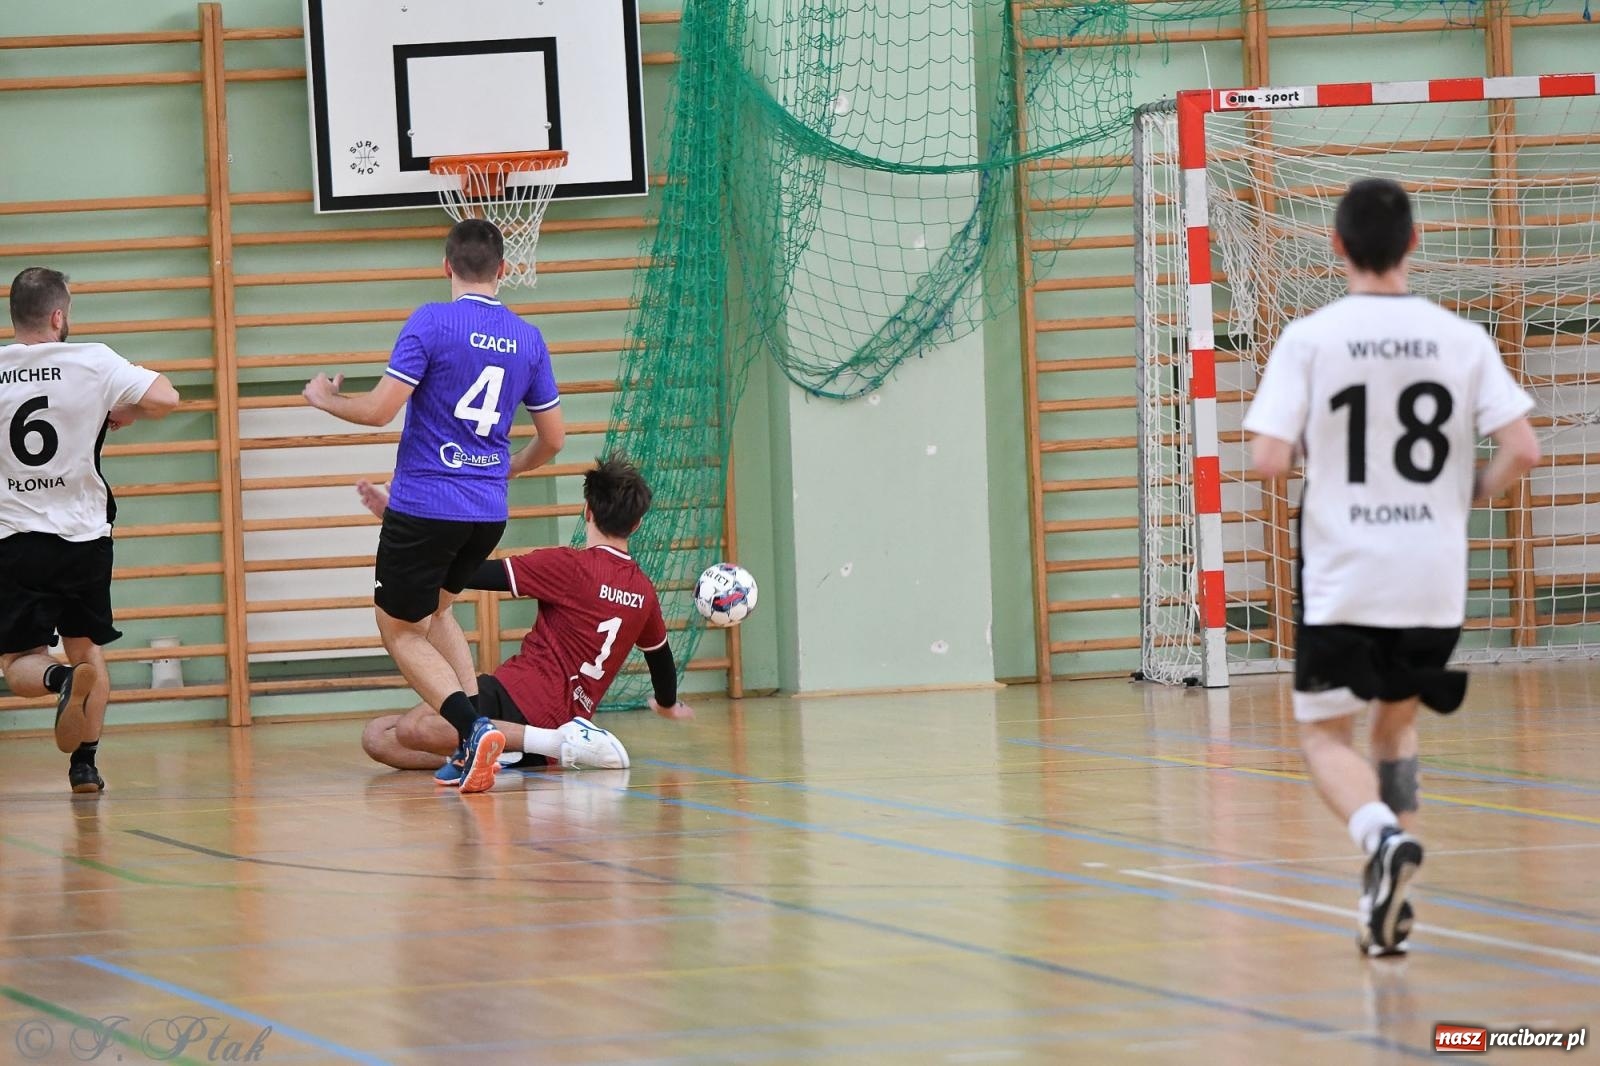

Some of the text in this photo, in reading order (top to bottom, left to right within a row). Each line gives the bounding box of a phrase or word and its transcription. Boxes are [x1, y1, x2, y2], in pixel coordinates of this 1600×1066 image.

[1265, 91, 1299, 104] sport
[349, 140, 380, 154] SURE
[350, 160, 380, 175] SHOT
[469, 332, 517, 354] CZACH
[1347, 338, 1439, 360] WICHER
[0, 367, 62, 384] WICHER
[453, 365, 505, 437] 4
[9, 395, 59, 467] 6
[1328, 380, 1454, 484] 18
[7, 477, 66, 493] PŁONIA
[1349, 504, 1434, 524] PŁONIA
[599, 584, 645, 609] BURDZY
[579, 616, 623, 681] 1
